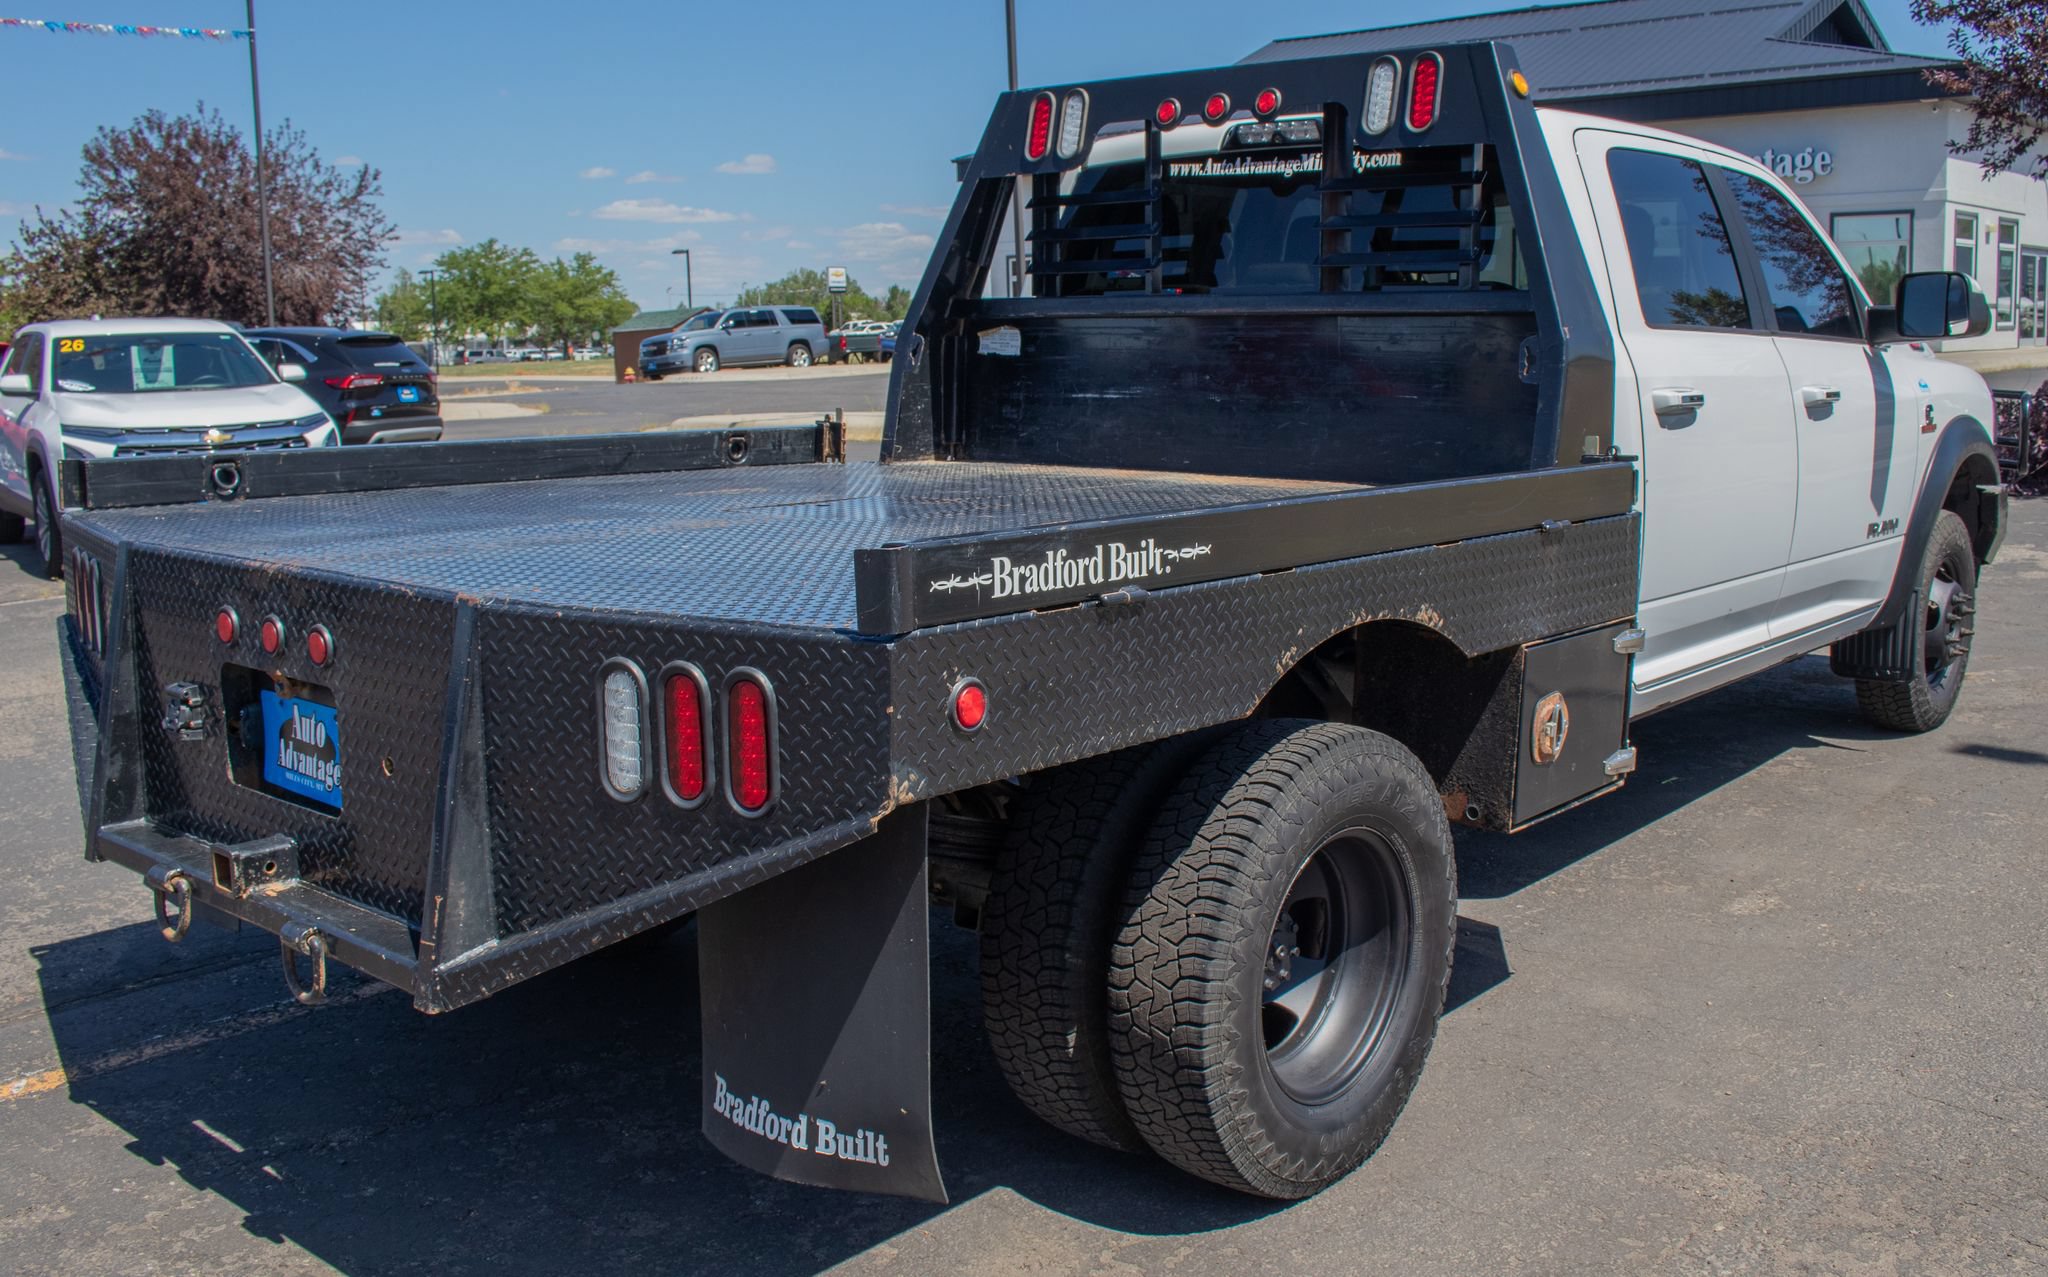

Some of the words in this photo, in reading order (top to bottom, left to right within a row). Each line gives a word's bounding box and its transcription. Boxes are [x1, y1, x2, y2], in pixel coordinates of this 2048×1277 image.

[1753, 146, 1832, 185] tage
[60, 338, 85, 353] 26
[1866, 517, 1899, 540] RAM
[991, 545, 1103, 599] Bradford
[1108, 538, 1172, 582] Built.
[291, 704, 326, 748] Auto
[277, 737, 342, 792] Advantage
[713, 1071, 808, 1150] Bradford
[815, 1118, 890, 1167] Built
